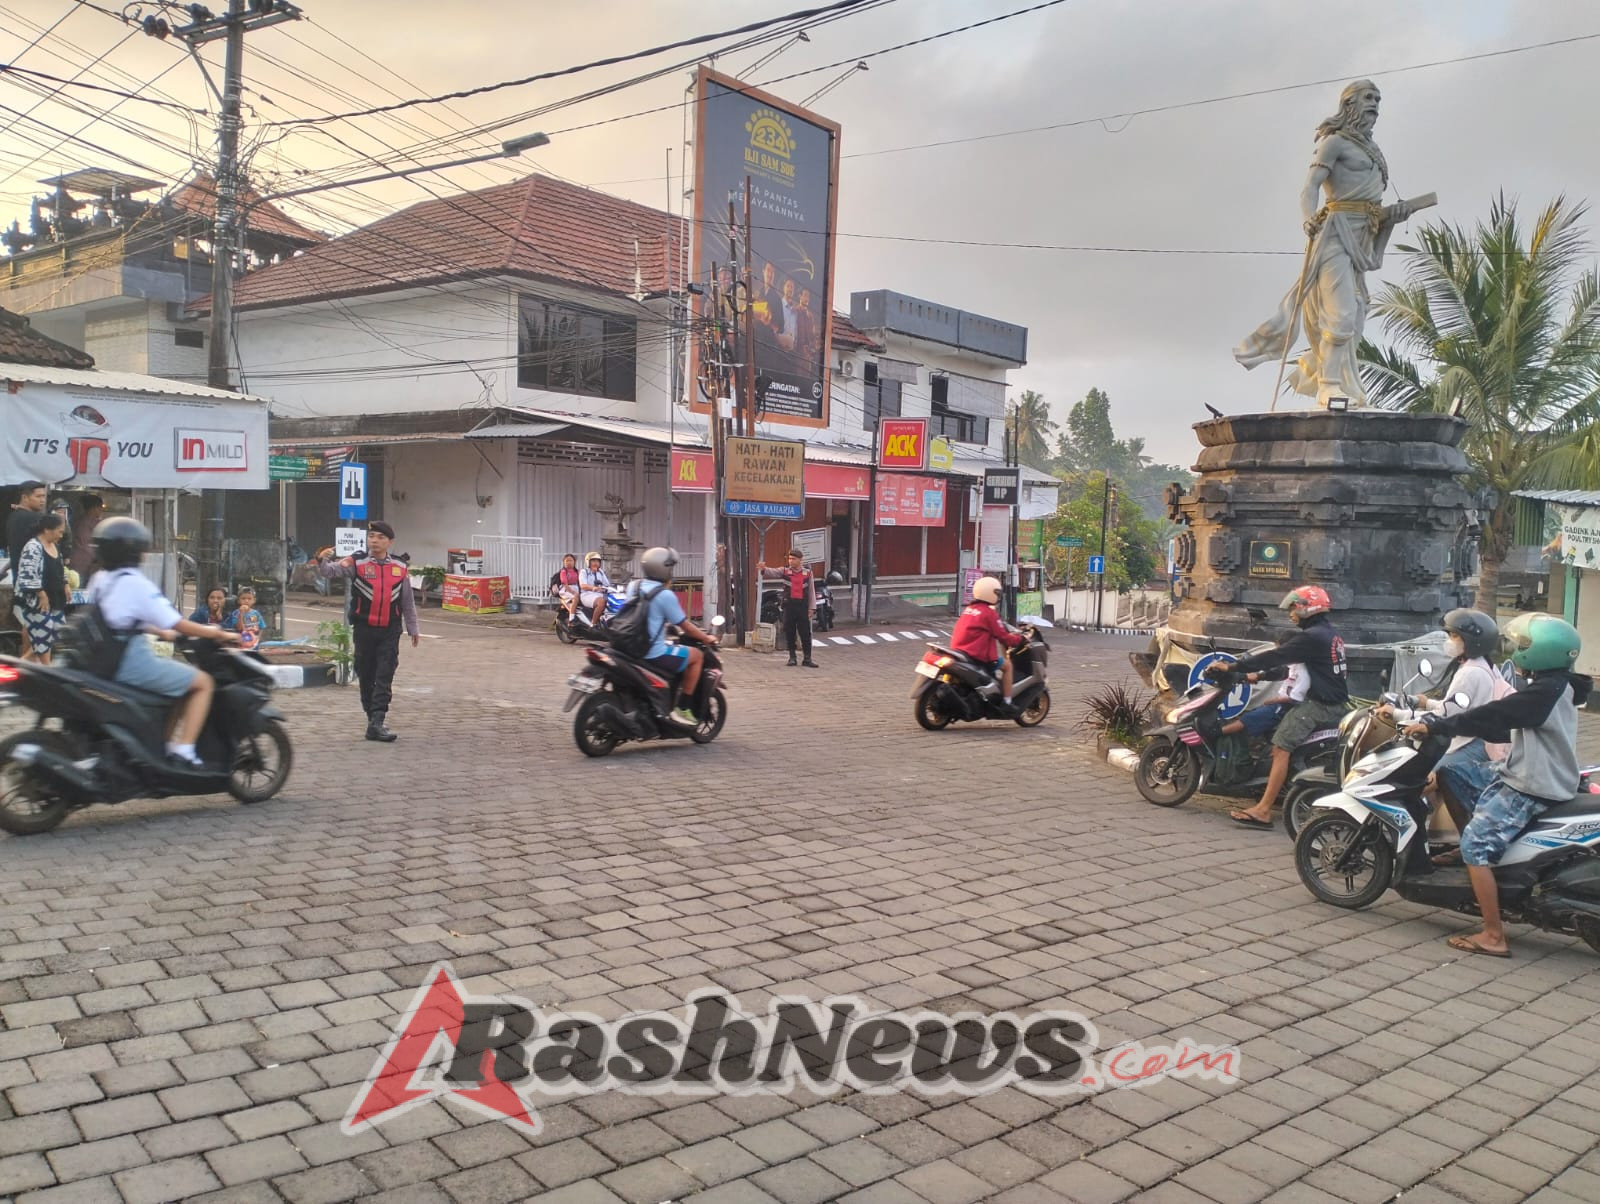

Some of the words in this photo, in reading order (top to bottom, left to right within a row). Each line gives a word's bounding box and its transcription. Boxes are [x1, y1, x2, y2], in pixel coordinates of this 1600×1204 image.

[756, 127, 786, 151] 234
[760, 154, 779, 172] SAM
[738, 180, 760, 195] KTA
[764, 189, 799, 209] PANTAS
[728, 189, 805, 222] MEAYAKANNYA
[23, 438, 60, 455] IT'S
[116, 441, 154, 458] YOU
[206, 443, 243, 460] MILD
[735, 442, 761, 456] HATI
[769, 445, 794, 459] HATI
[885, 434, 918, 457] ACK
[679, 459, 697, 481] ACK
[743, 457, 786, 471] RAWAN
[734, 471, 795, 485] KECELAKAAN
[743, 503, 761, 513] JASA
[763, 504, 795, 516] RAHARJA
[1567, 534, 1592, 544] POULTRY
